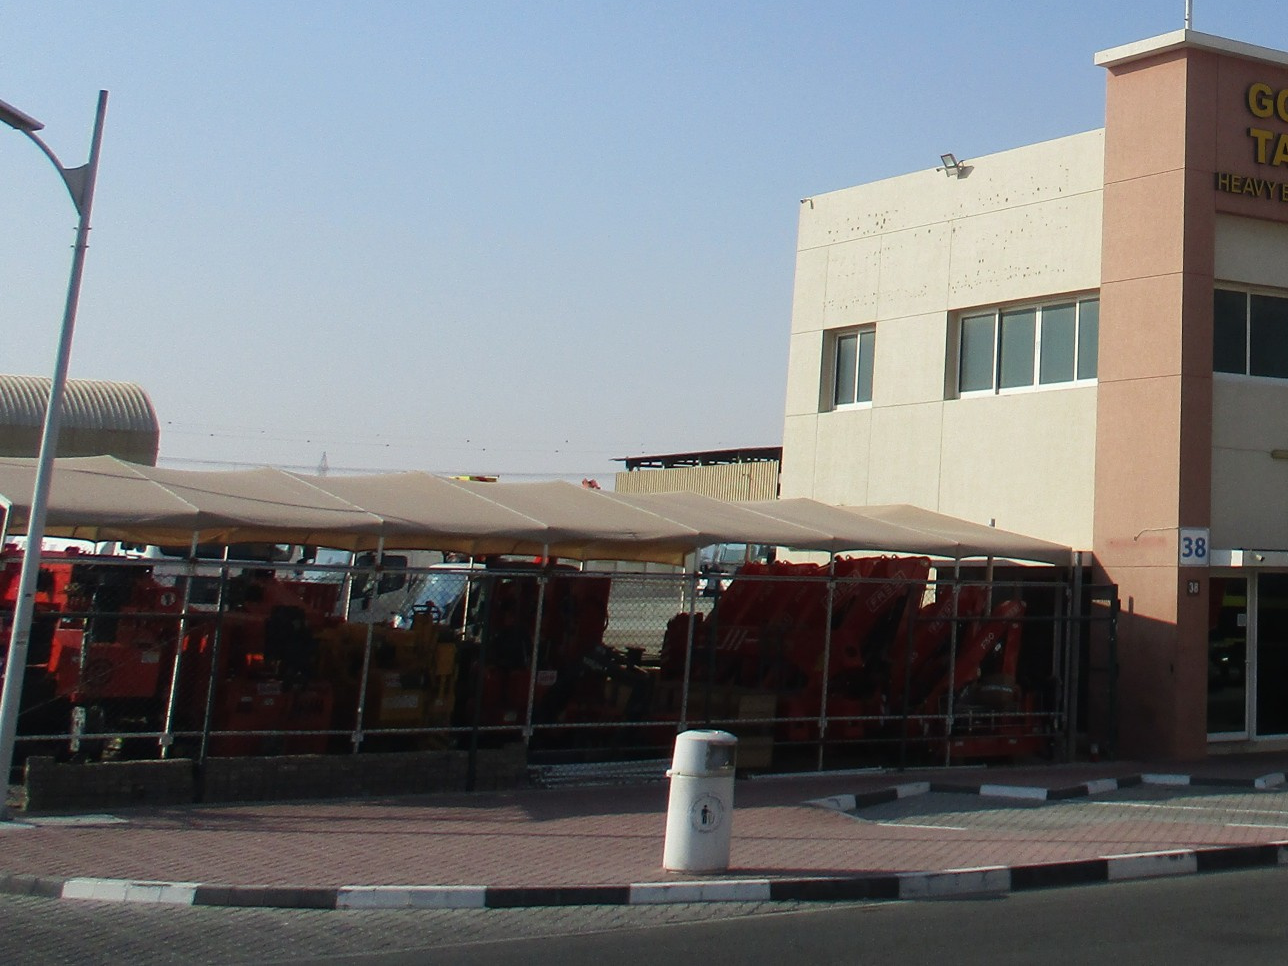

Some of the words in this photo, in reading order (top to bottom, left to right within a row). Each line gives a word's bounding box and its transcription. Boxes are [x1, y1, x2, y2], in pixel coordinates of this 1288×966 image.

[1216, 171, 1276, 200] HEAVY
[1182, 537, 1207, 558] 38
[1188, 581, 1199, 594] 38
